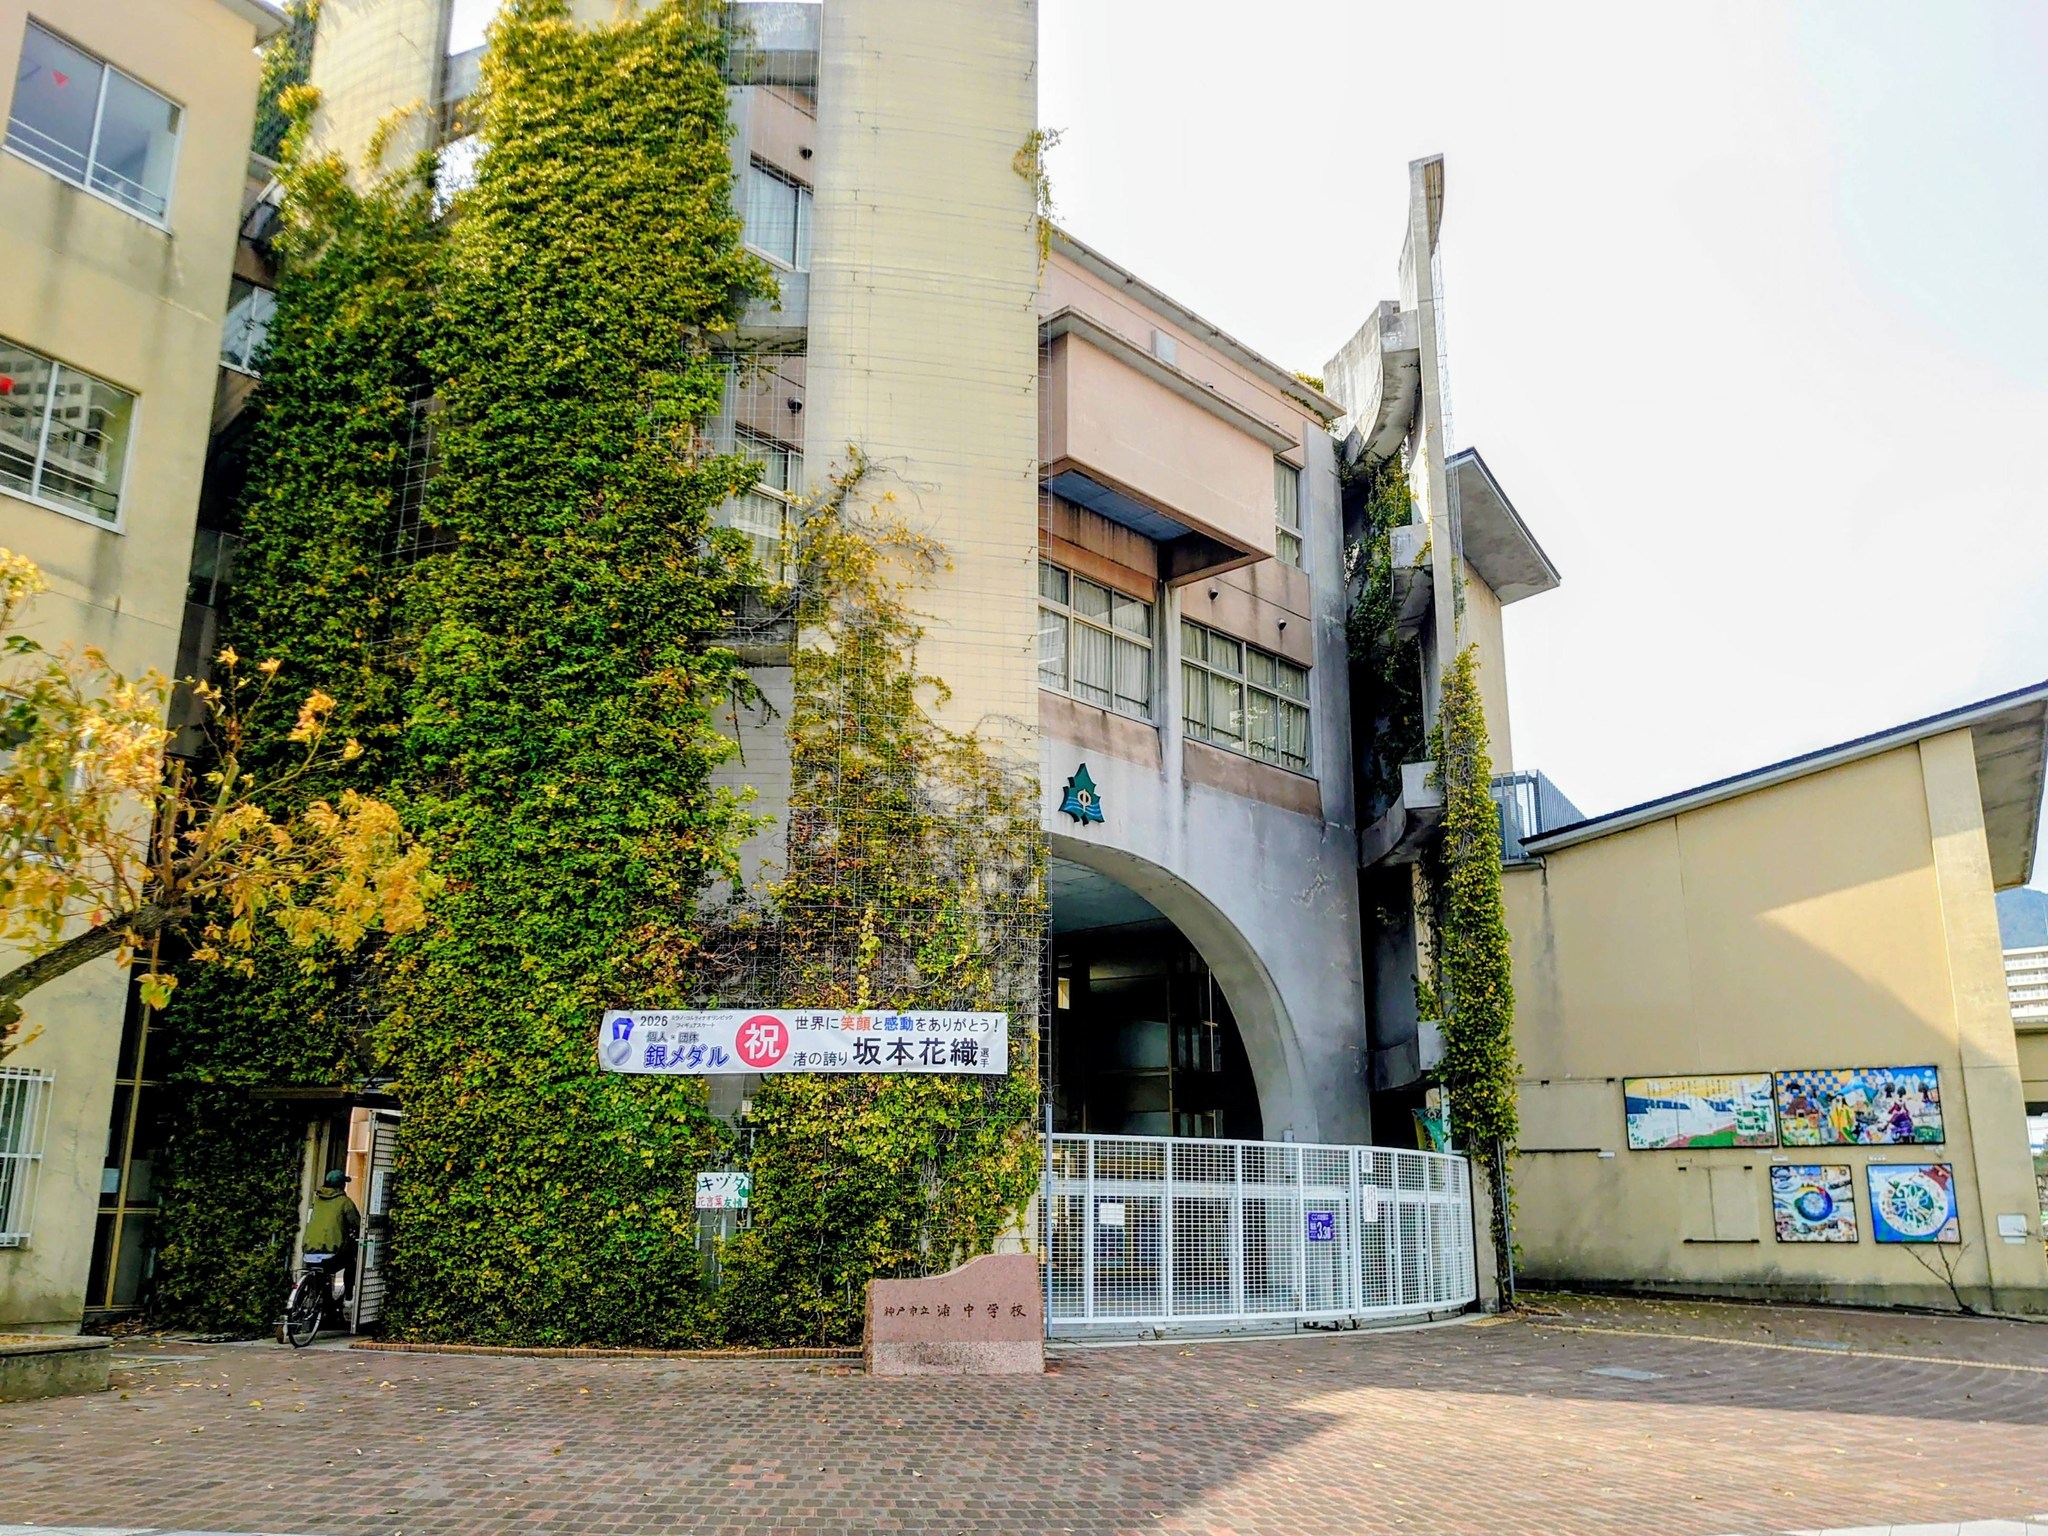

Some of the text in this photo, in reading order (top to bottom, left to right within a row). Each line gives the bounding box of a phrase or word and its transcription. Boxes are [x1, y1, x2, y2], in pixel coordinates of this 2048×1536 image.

[640, 1015, 668, 1027] 2026
[795, 1015, 999, 1033] 世界に笑顔と感動をありがとう！
[646, 1031, 699, 1043] 個人・団体
[743, 1023, 781, 1060] 祝
[644, 1044, 730, 1069] 銀メダル
[793, 1051, 848, 1067] 渚の誇り
[852, 1036, 979, 1066] 坂本花織
